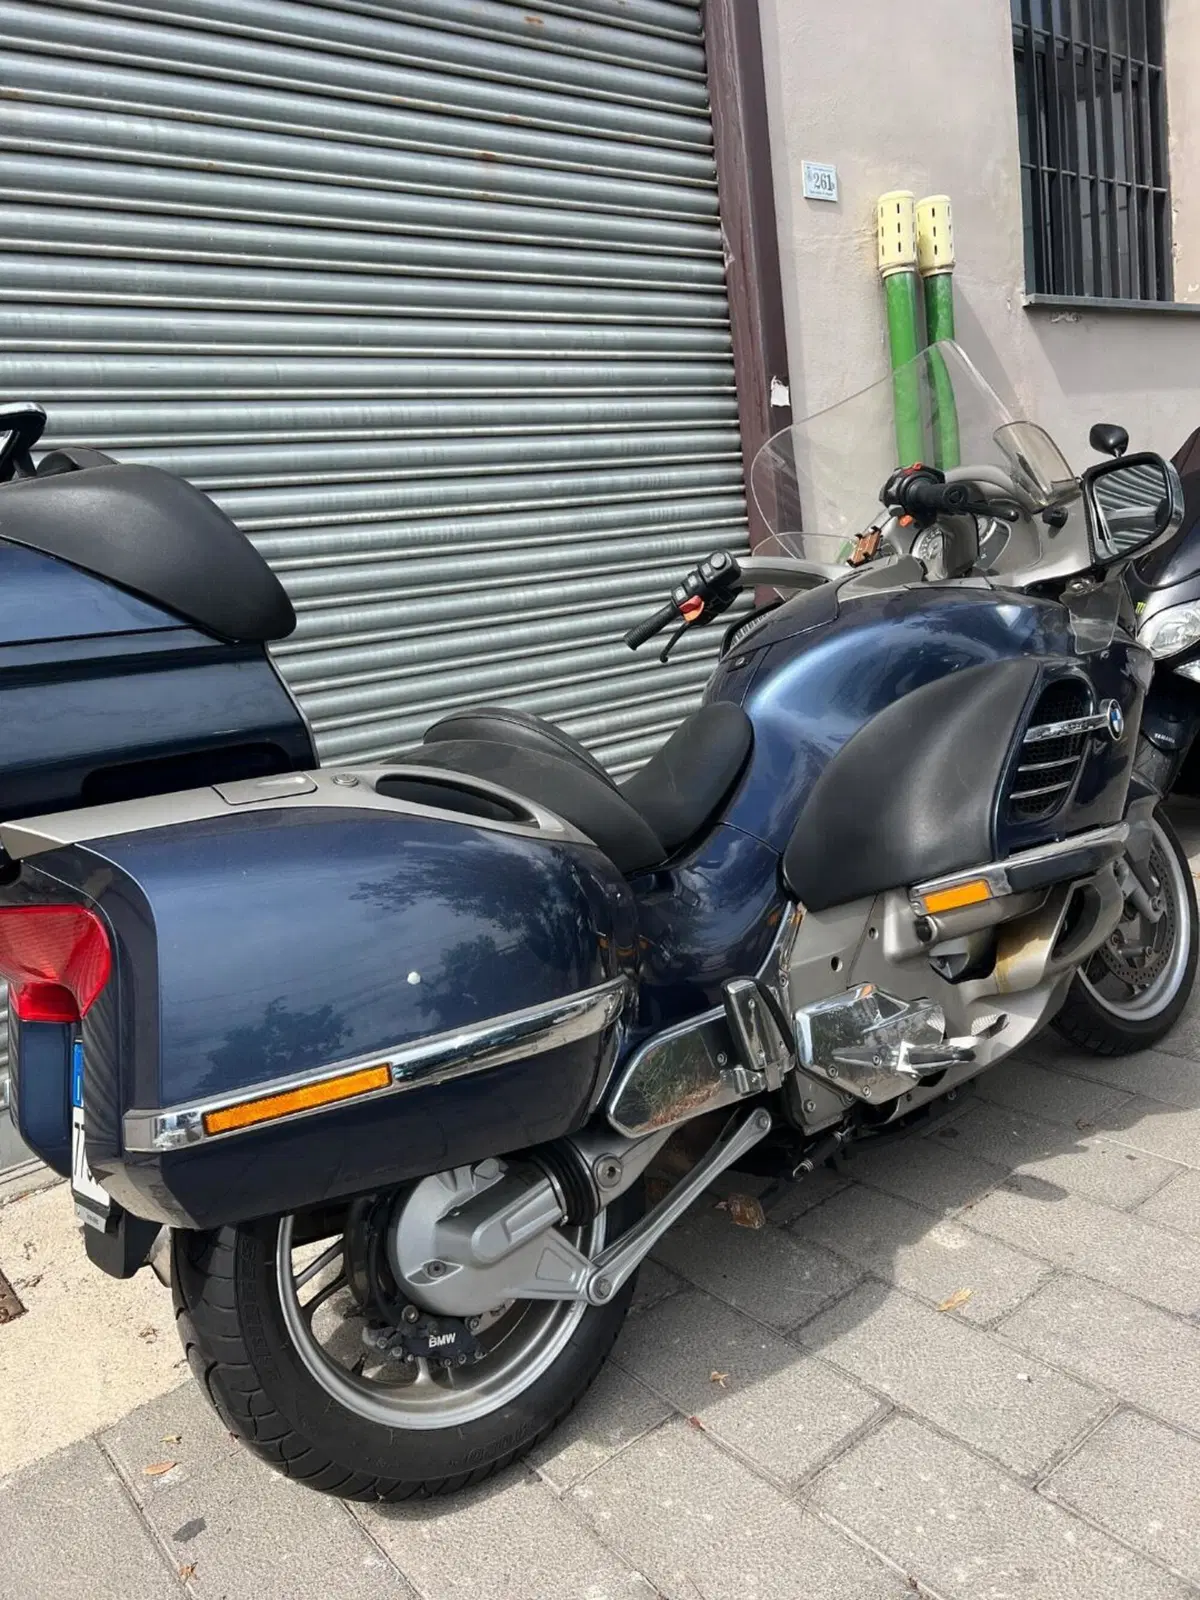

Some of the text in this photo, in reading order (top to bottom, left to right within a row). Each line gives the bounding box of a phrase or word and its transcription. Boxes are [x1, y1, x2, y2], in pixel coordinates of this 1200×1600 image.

[813, 172, 833, 191] 261
[1154, 732, 1175, 744] YAMAHA
[428, 1332, 456, 1348] BMW
